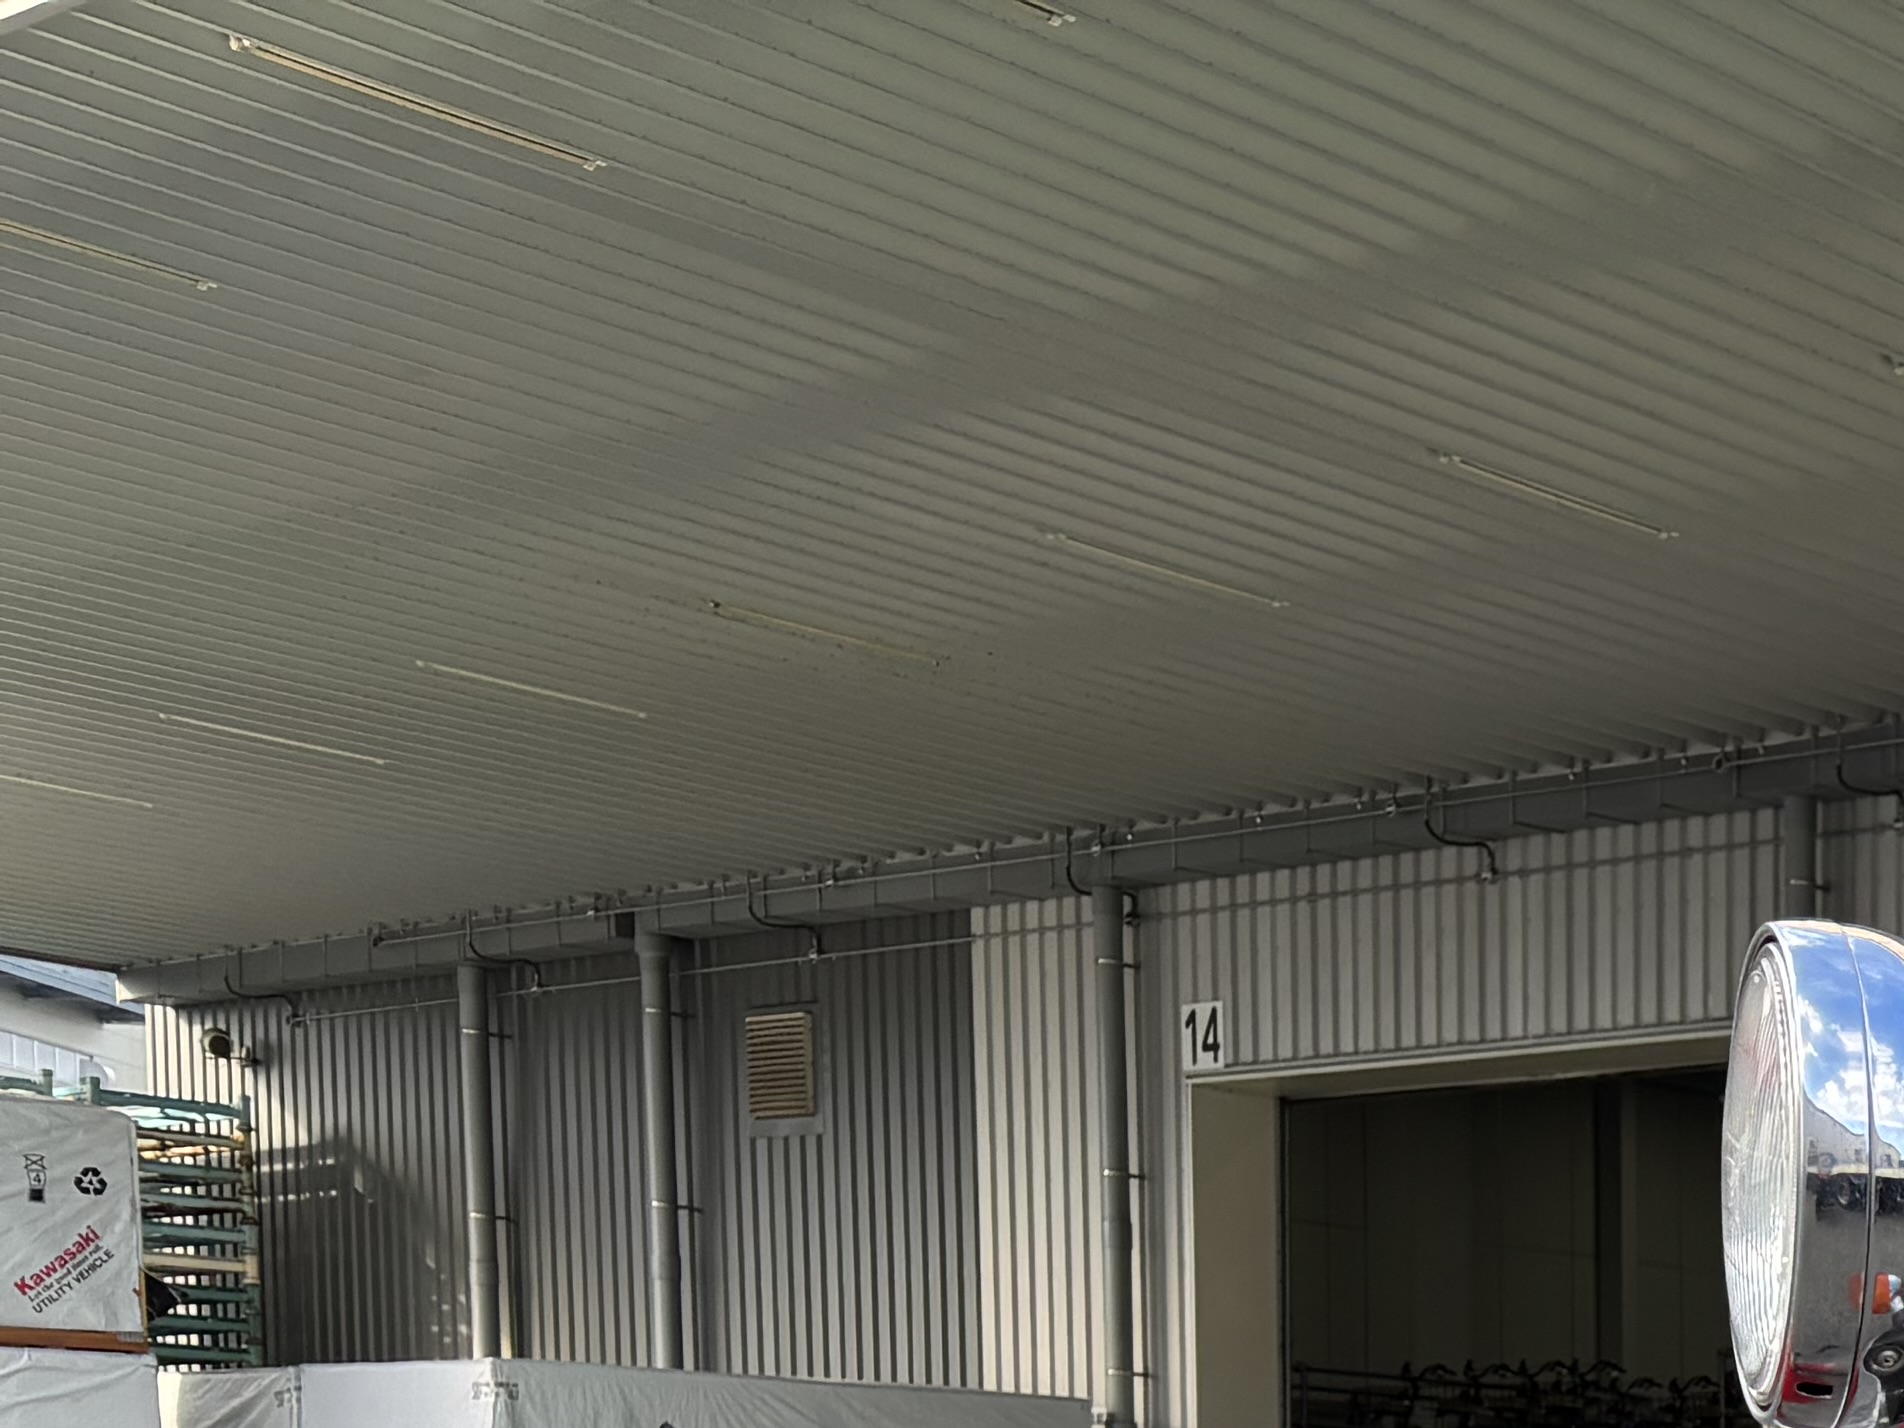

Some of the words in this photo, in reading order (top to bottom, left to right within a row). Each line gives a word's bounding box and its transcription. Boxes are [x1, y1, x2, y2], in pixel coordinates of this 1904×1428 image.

[1185, 1006, 1220, 1066] 14
[14, 1225, 101, 1296] Kawasaki
[32, 1281, 74, 1314] UTILITY
[73, 1249, 114, 1284] VEHICLE
